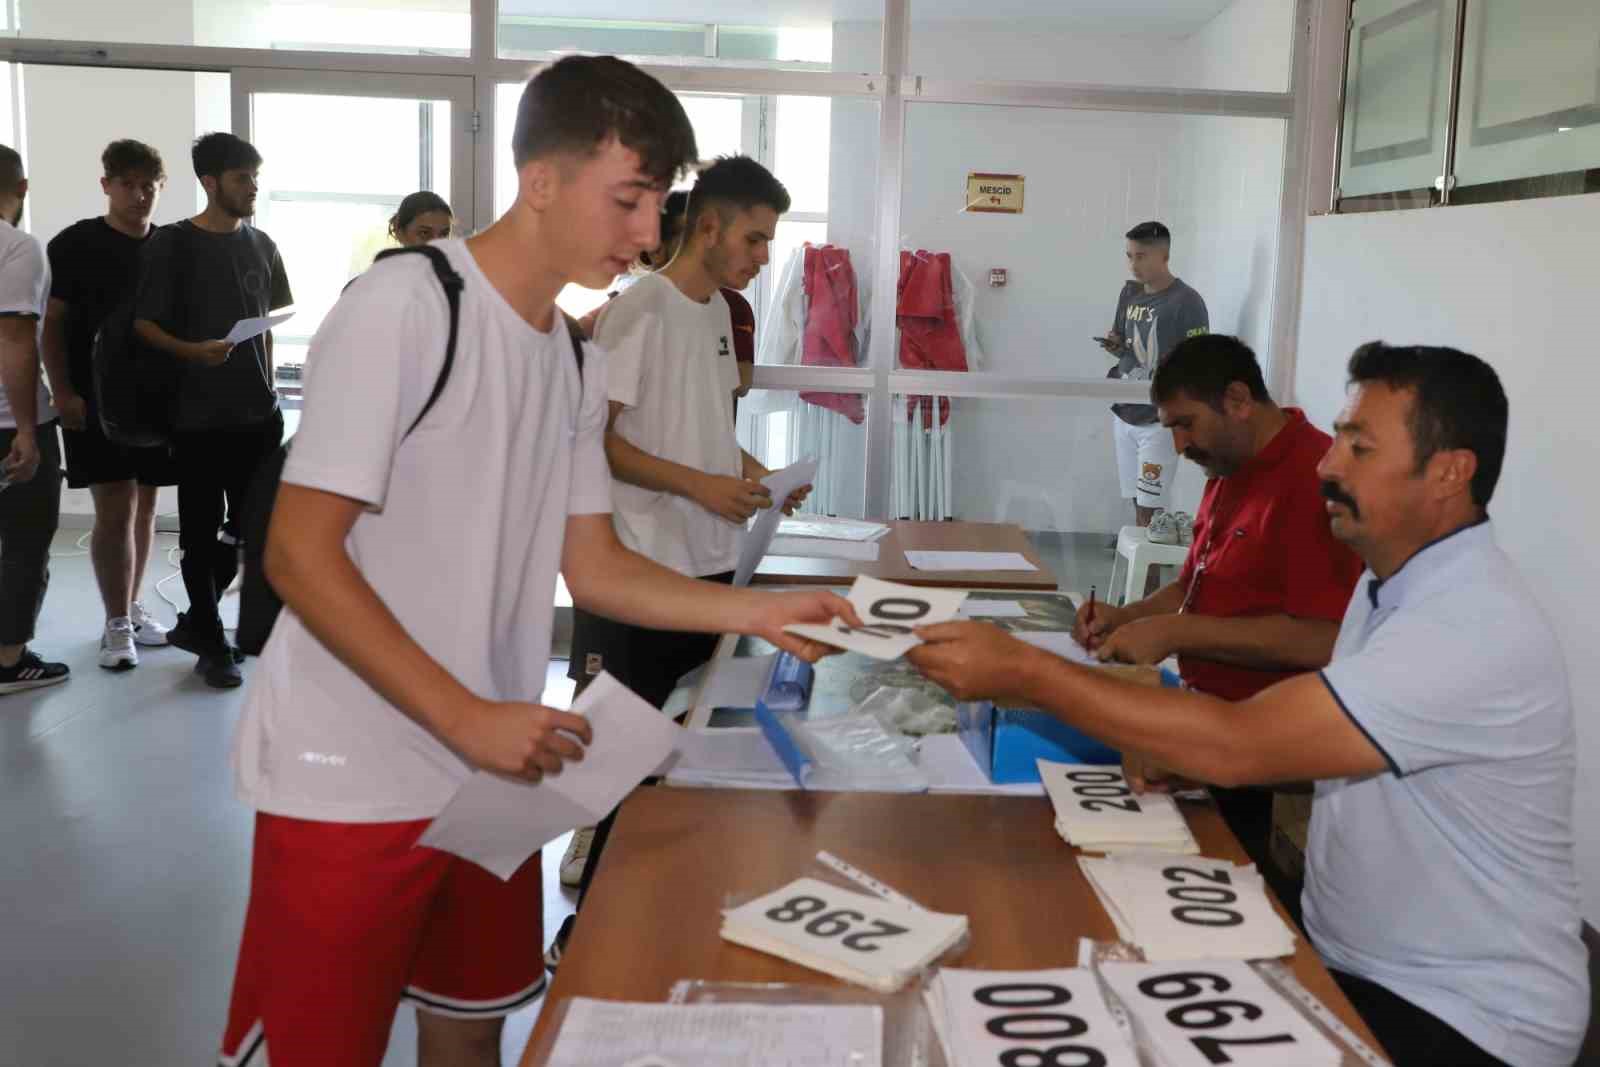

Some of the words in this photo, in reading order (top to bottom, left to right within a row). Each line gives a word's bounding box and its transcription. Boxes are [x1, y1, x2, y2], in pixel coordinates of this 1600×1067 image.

[1066, 771, 1142, 813] 200
[765, 896, 910, 952] 298
[1162, 866, 1244, 927] 002
[973, 983, 1107, 1067] 800
[1137, 971, 1296, 1065] 799
